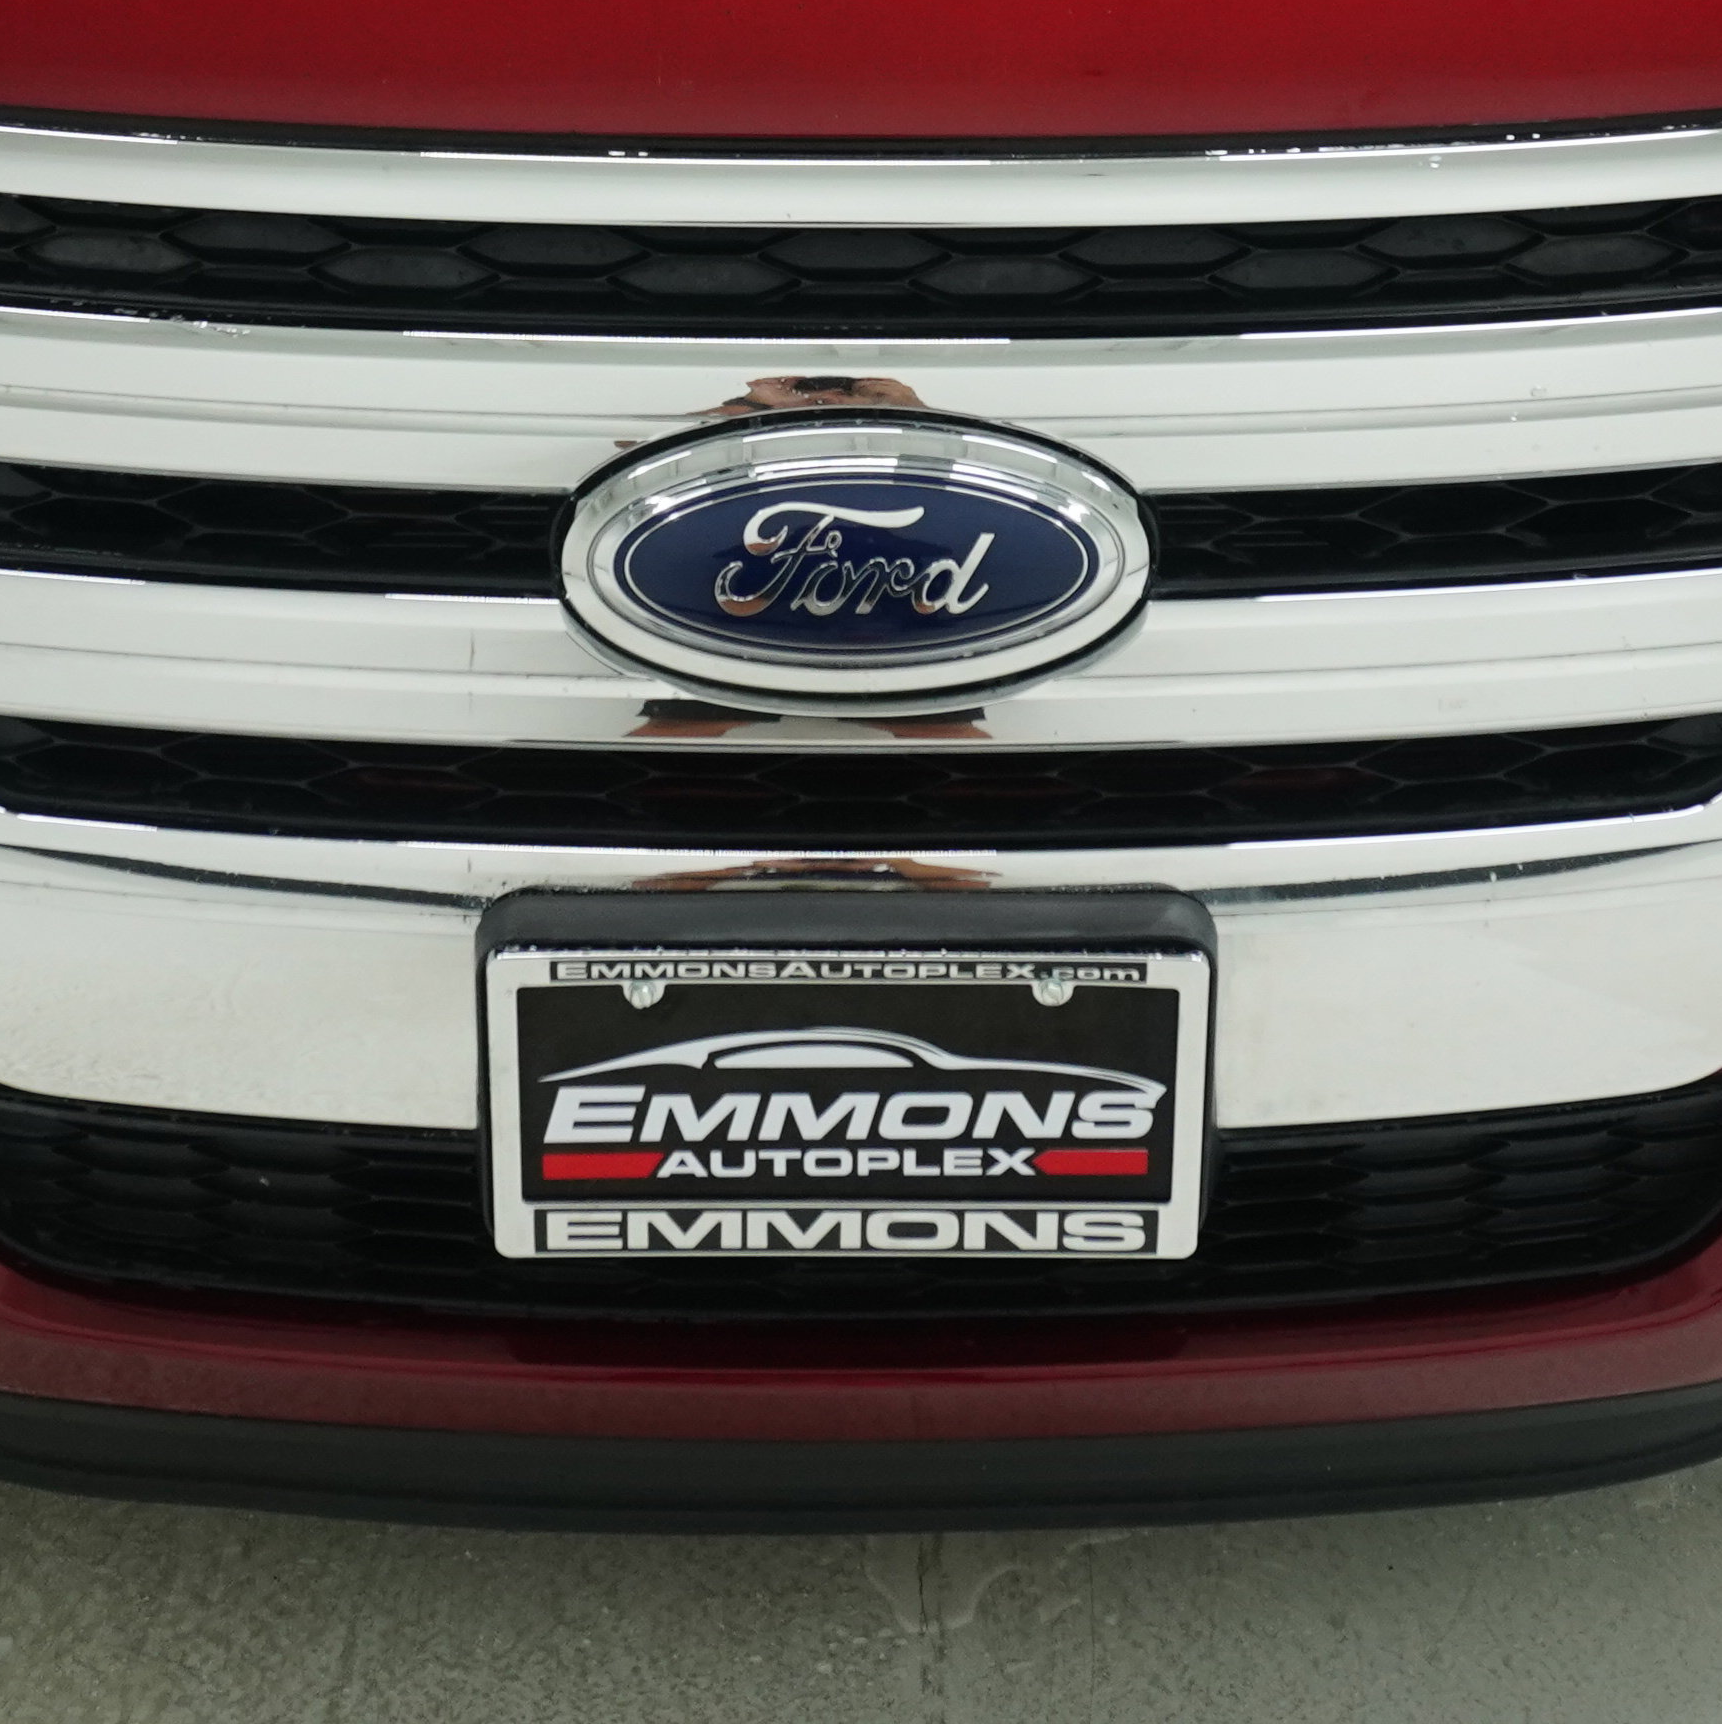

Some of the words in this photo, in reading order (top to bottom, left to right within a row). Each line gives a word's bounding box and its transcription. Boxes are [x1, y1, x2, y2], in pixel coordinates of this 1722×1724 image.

[714, 501, 996, 616] Ford
[542, 1085, 1158, 1144] EMMONS
[655, 1147, 1037, 1179] AUTOPLEX
[544, 1209, 1148, 1252] EMMONS
